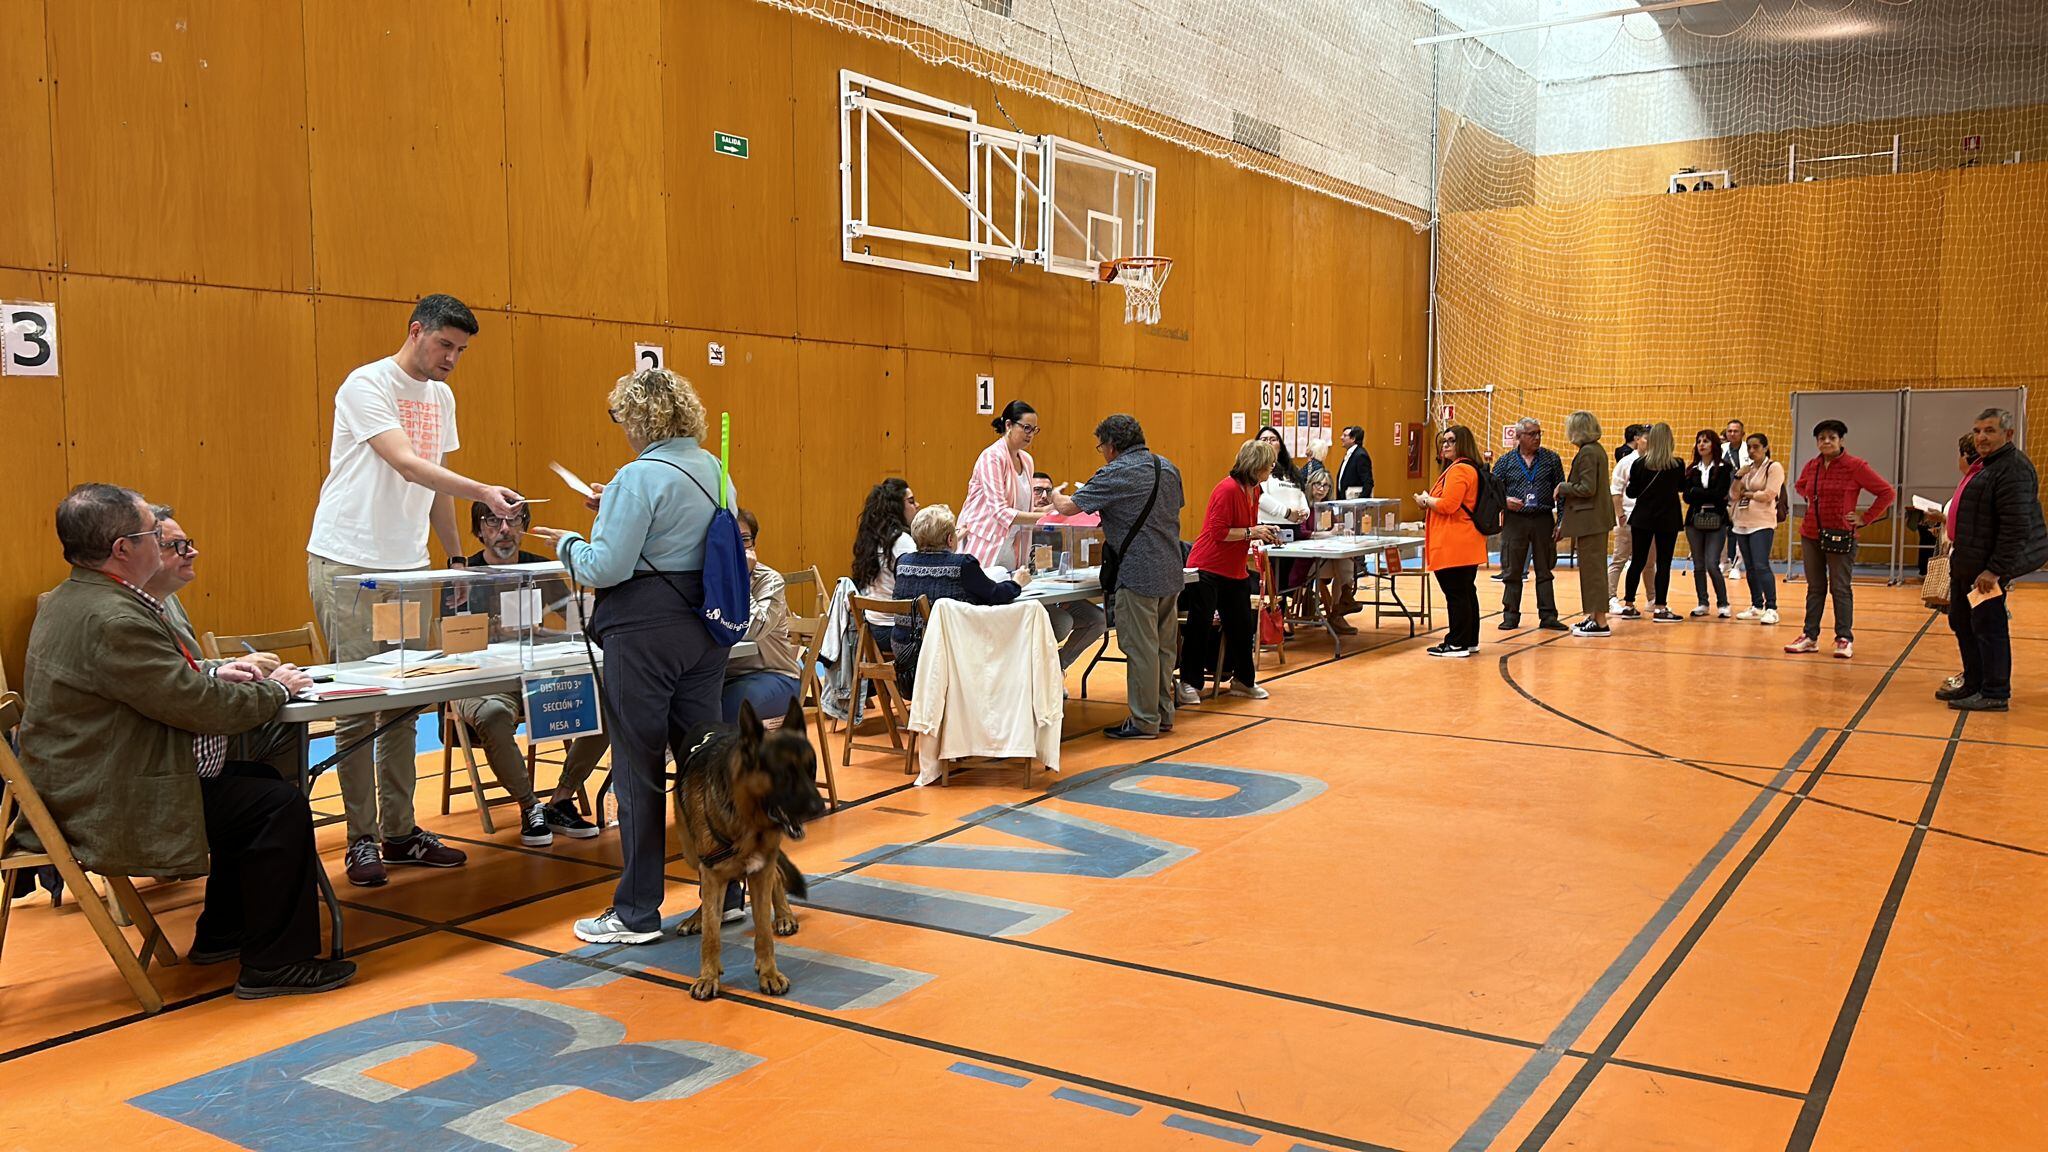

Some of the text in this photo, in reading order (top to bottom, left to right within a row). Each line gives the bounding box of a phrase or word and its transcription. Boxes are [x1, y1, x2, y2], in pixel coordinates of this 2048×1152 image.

[721, 135, 741, 146] SALIDA
[11, 311, 51, 367] 3
[980, 380, 992, 410] 1
[1262, 383, 1269, 406] 6
[1274, 384, 1281, 407] 5
[1287, 385, 1294, 408] 4
[1300, 386, 1307, 408] 3
[1312, 387, 1318, 408] 2
[1324, 388, 1330, 409] 1
[540, 681, 573, 693] DISTRITO
[542, 698, 573, 713] SECCIÓN
[549, 718, 581, 732] MESA B
[407, 843, 428, 860] N
